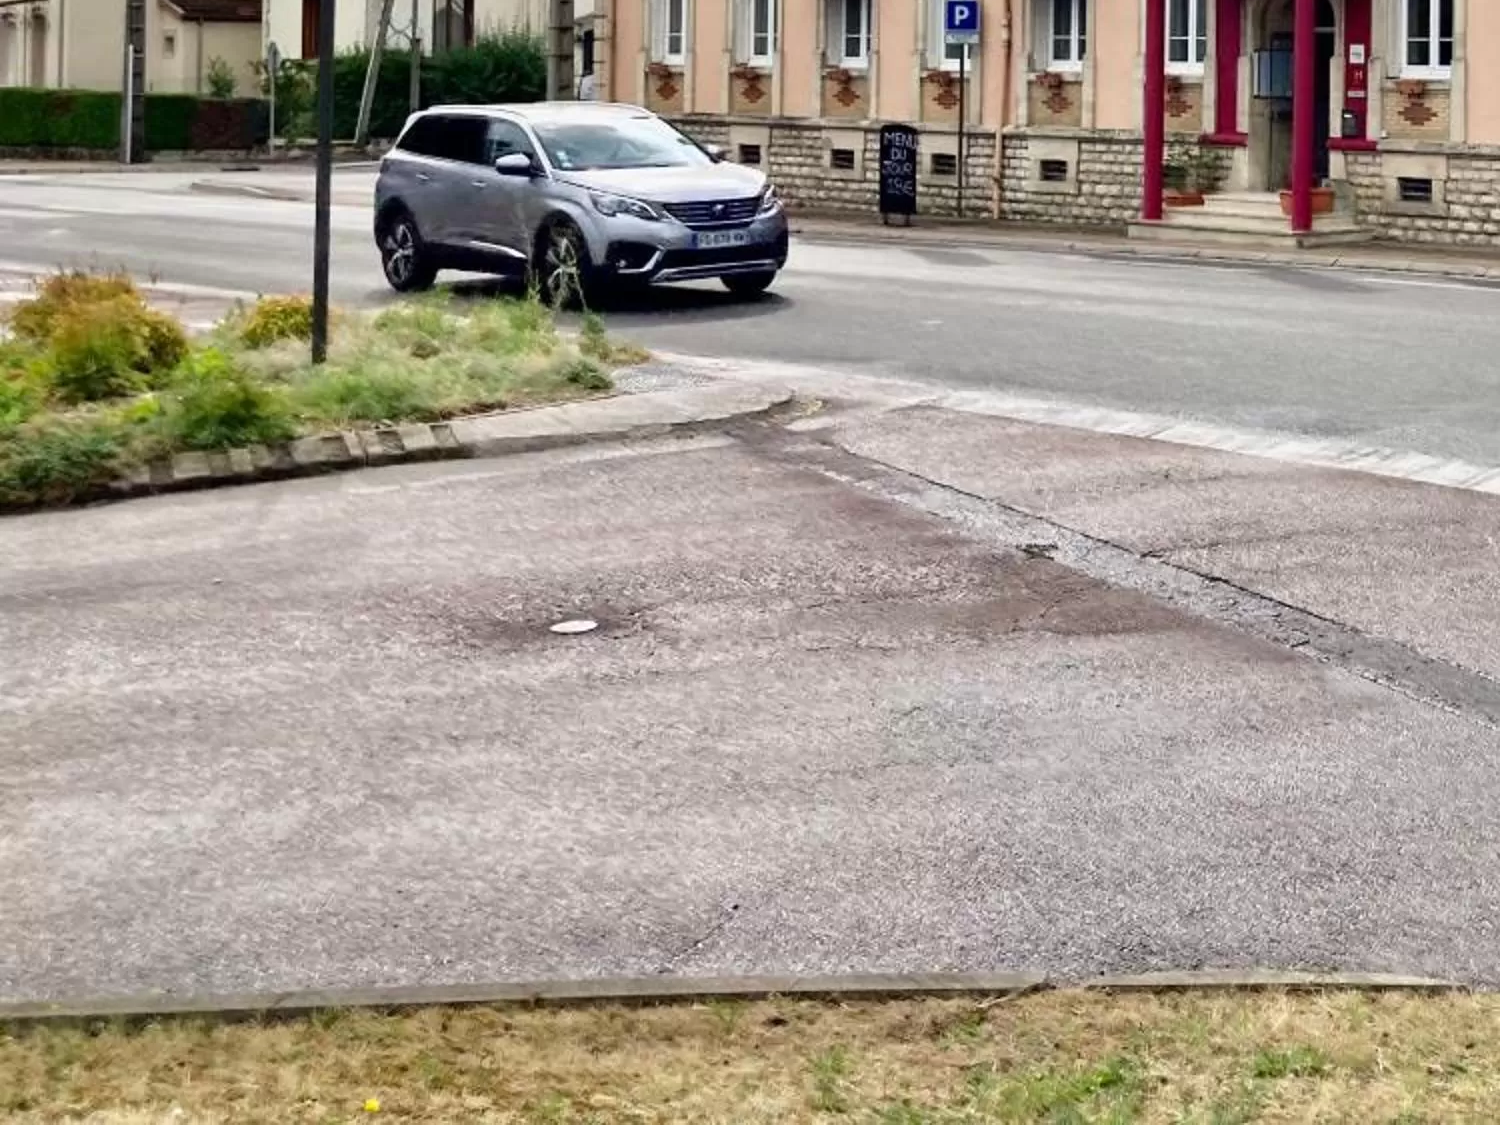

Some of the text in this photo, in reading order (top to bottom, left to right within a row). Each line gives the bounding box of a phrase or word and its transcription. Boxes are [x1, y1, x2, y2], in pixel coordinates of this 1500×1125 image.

[954, 5, 969, 26] P
[883, 132, 918, 149] MENU
[891, 146, 907, 161] DU
